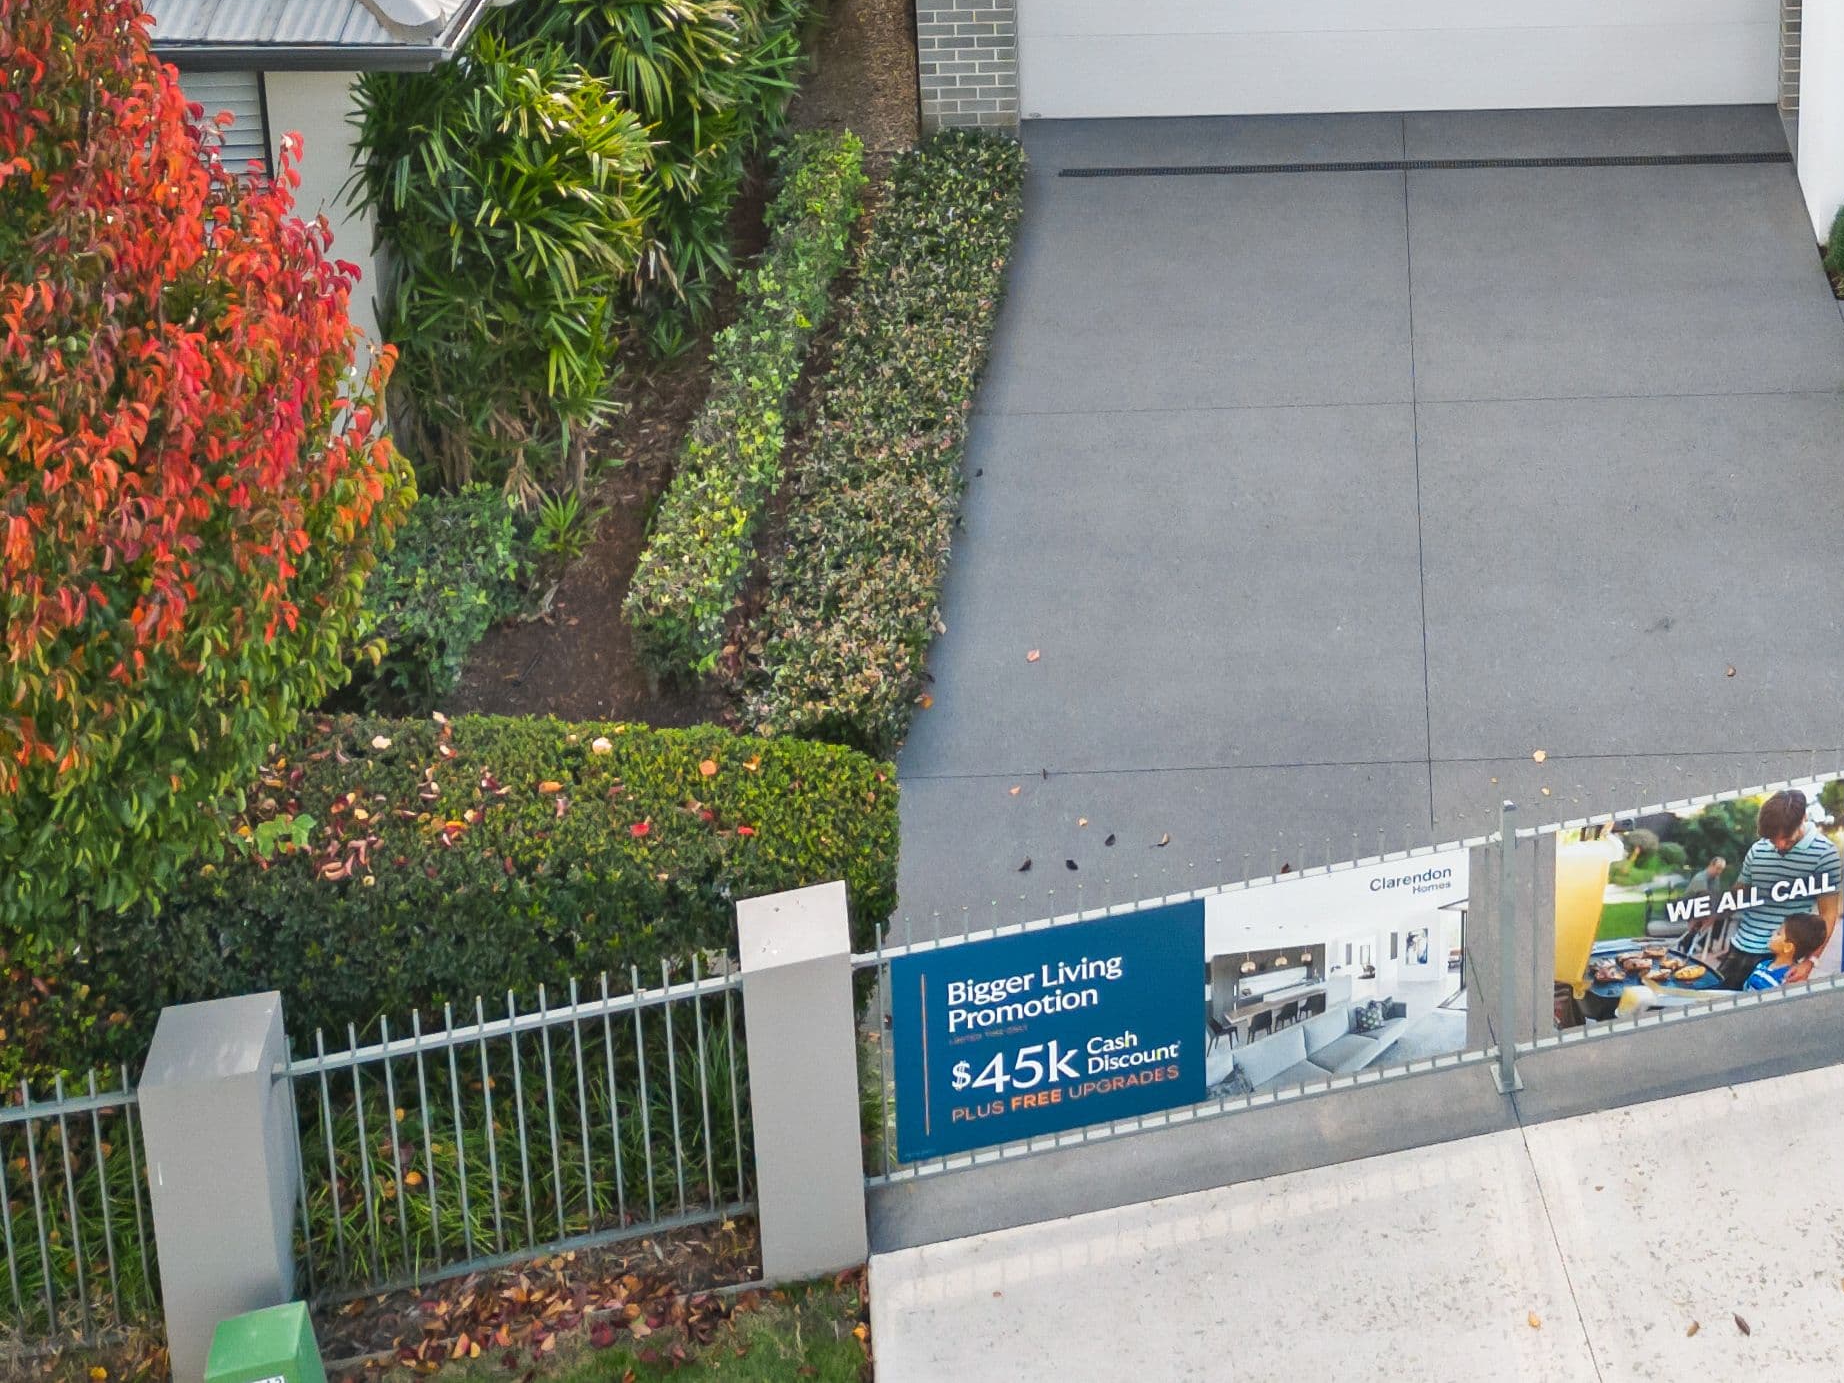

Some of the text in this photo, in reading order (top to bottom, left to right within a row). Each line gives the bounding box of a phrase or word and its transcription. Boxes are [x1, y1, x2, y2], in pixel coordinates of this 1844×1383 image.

[1369, 868, 1452, 892] Clarendon
[1412, 881, 1451, 894] Homes
[1667, 895, 1711, 922] WE
[1716, 887, 1764, 914] ALL
[1771, 872, 1837, 902] CALL
[947, 956, 1123, 1006] Bigger Living
[948, 988, 1098, 1033] Promotion
[951, 1039, 1081, 1093] $45k
[1086, 1030, 1138, 1055] Cash
[952, 1065, 1180, 1123] PLUS FREE UPGRADES
